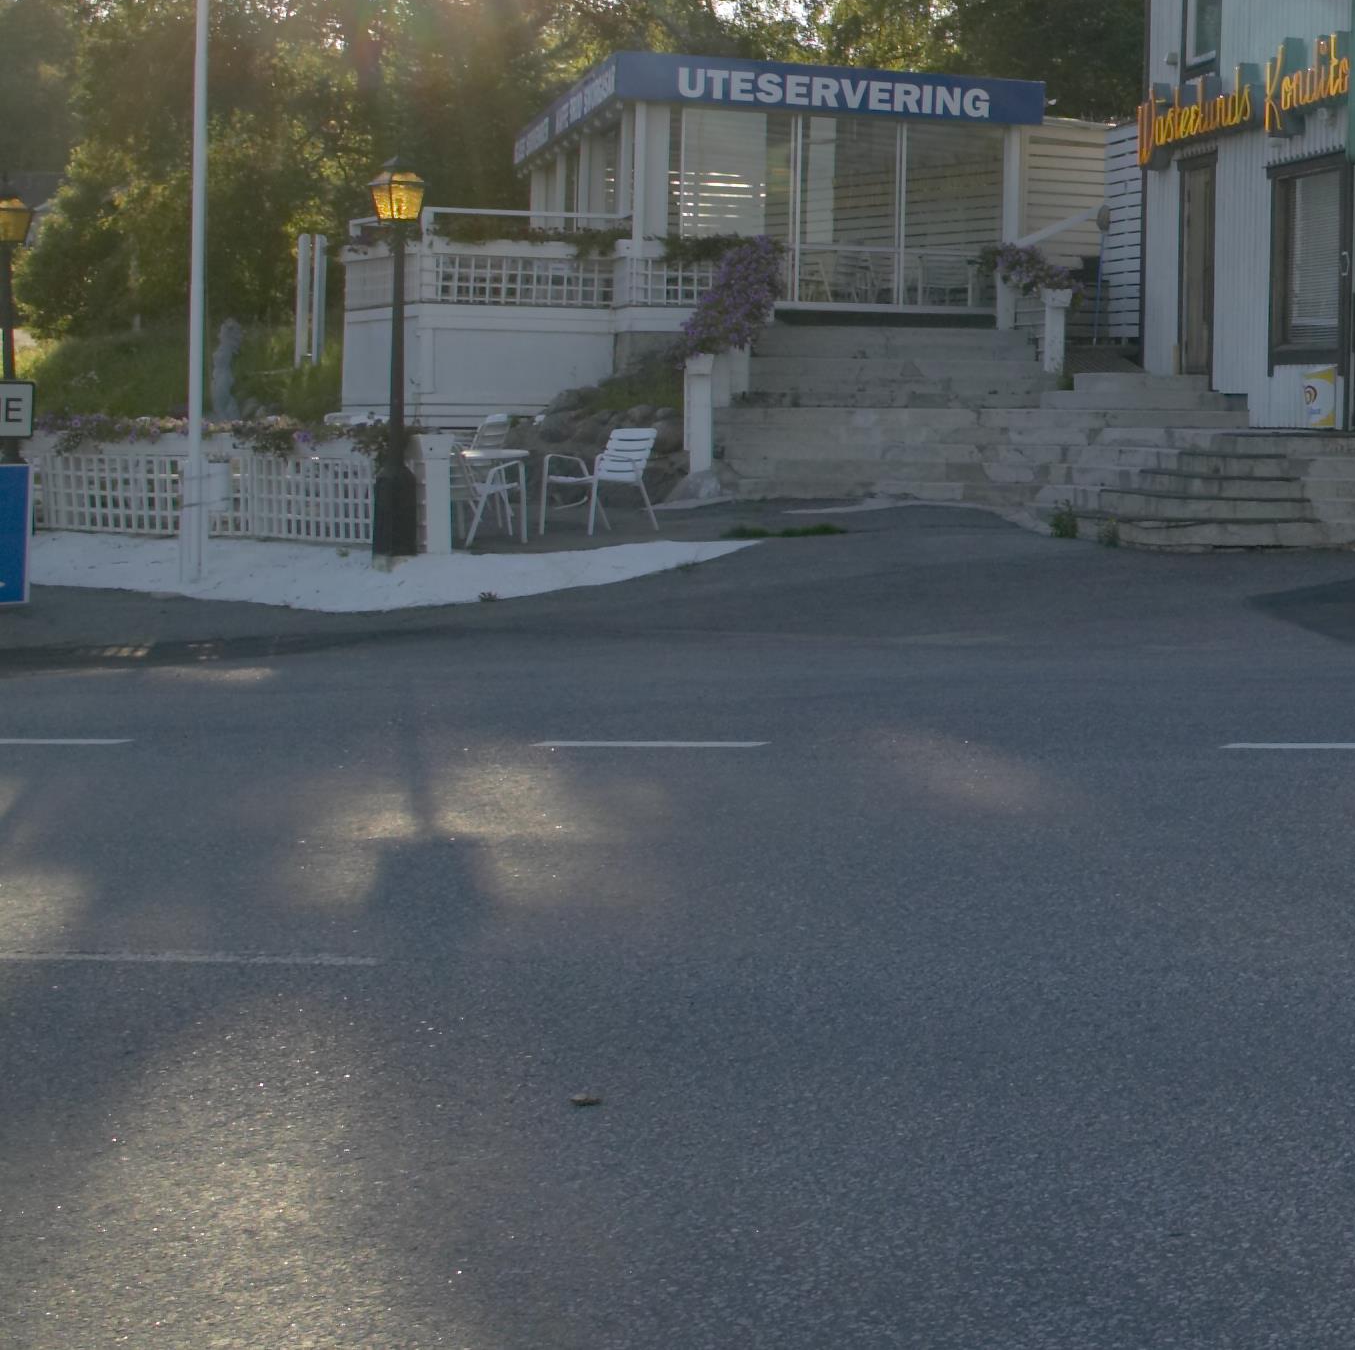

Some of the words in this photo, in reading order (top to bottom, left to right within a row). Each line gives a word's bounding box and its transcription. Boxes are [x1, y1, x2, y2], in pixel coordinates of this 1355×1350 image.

[677, 66, 990, 119] UTESERVERING
[1136, 66, 1251, 166] Wästerlunds
[1264, 32, 1351, 133] Kondito
